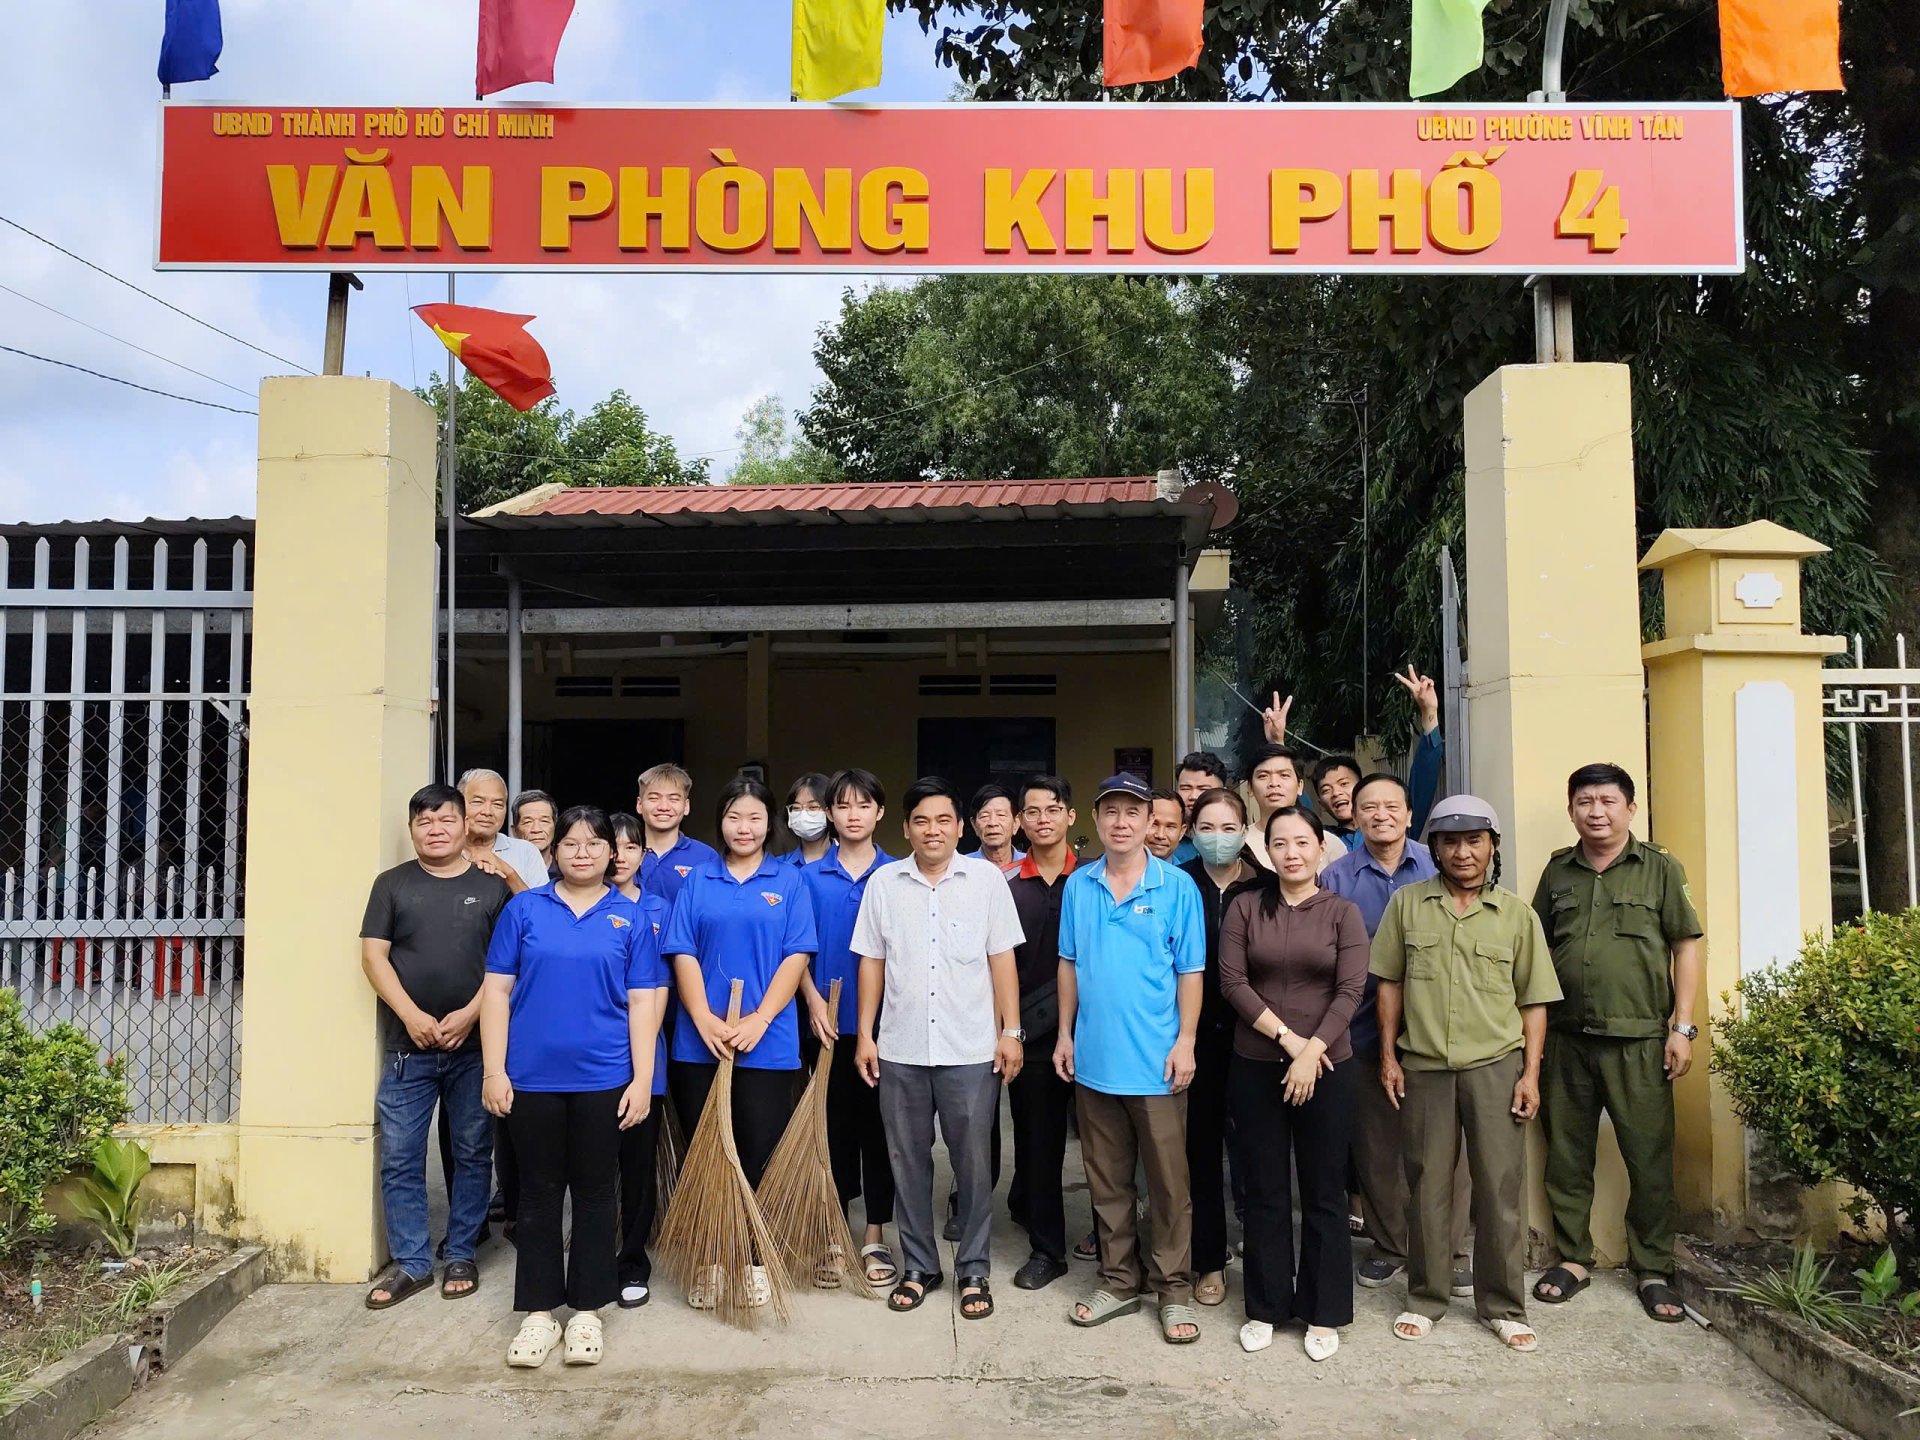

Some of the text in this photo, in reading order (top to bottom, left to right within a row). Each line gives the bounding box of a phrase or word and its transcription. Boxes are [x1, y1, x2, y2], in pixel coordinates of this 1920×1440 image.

[213, 112, 273, 136] UBND
[281, 109, 356, 137] THÀNH
[453, 109, 490, 138] CHÍ
[498, 113, 554, 138] MINH
[1417, 116, 1477, 141] UBND
[1639, 112, 1684, 140] TÂN
[266, 145, 1630, 256] VĂN PHÒNG KHU PHỐ 4
